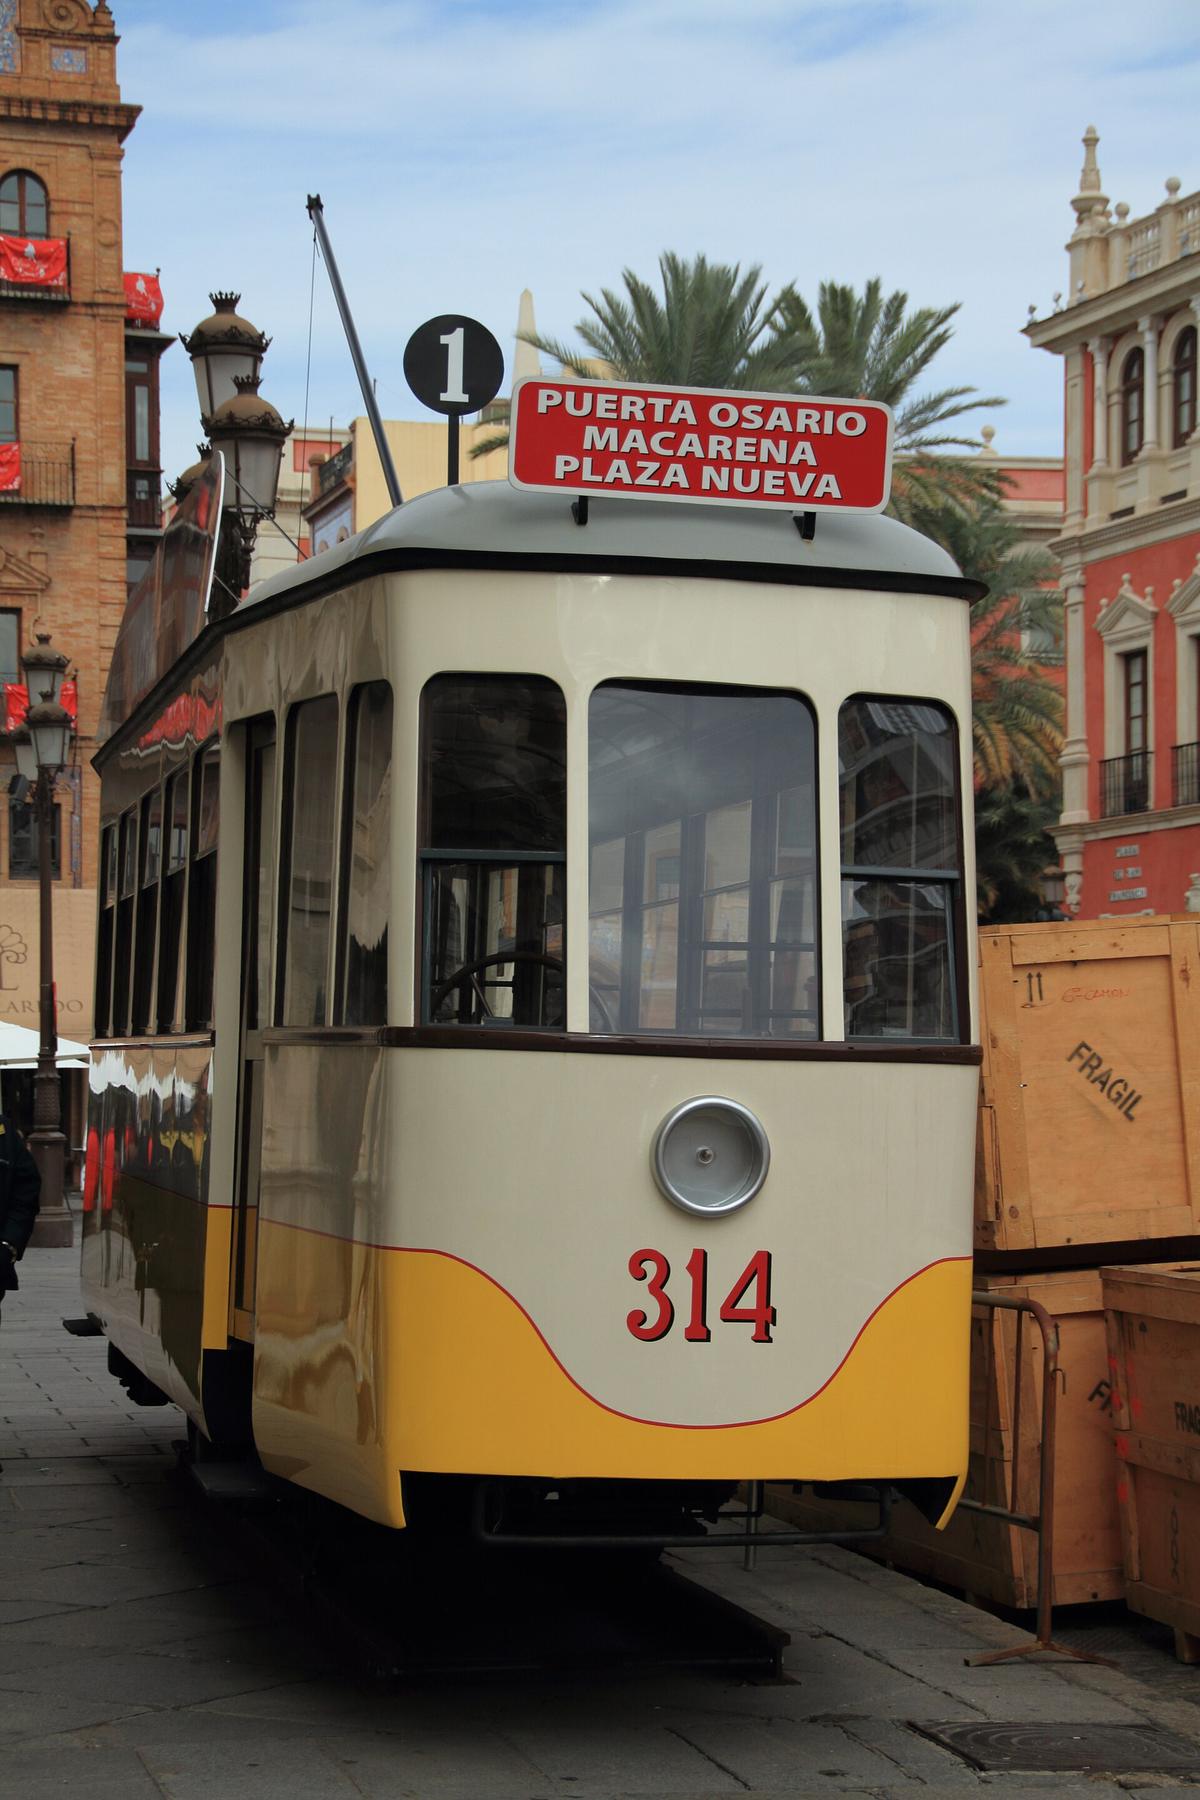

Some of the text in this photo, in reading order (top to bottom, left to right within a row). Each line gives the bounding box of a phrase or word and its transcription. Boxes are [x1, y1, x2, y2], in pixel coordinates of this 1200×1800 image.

[439, 327, 469, 403] 1
[537, 389, 868, 437] PUERTA OSARIO
[582, 425, 818, 467] MACARENA
[554, 455, 843, 500] PLAZA NUEVA
[1066, 1041, 1143, 1122] FRAGIL
[626, 1248, 777, 1343] 314
